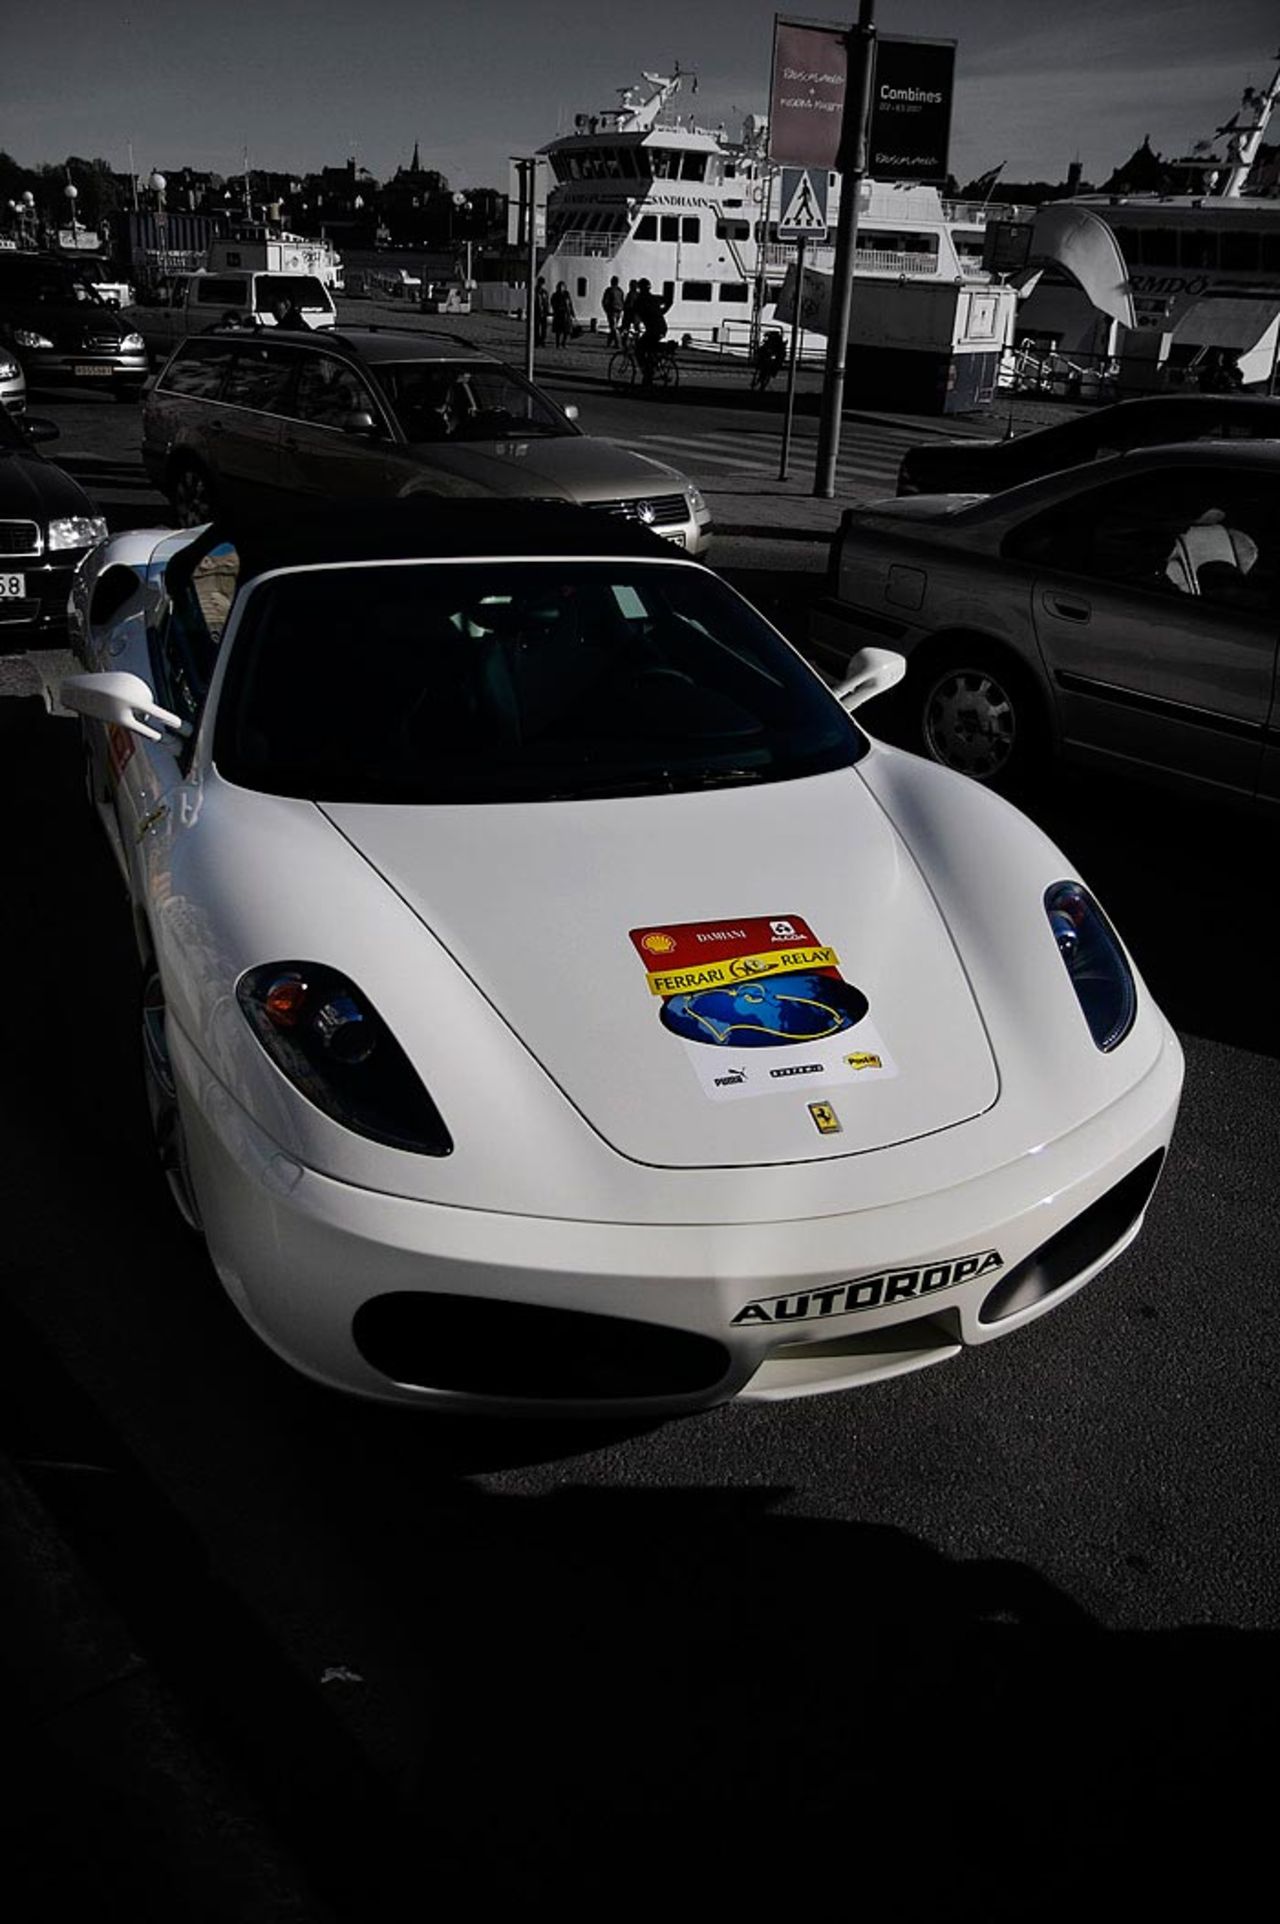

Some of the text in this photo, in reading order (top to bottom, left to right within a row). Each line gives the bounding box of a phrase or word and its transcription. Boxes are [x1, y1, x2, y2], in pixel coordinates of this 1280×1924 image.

[881, 84, 943, 104] Combines
[654, 968, 725, 991] FERRARI
[780, 950, 831, 967] RELAY
[731, 1252, 1004, 1323] AUTOROPA
